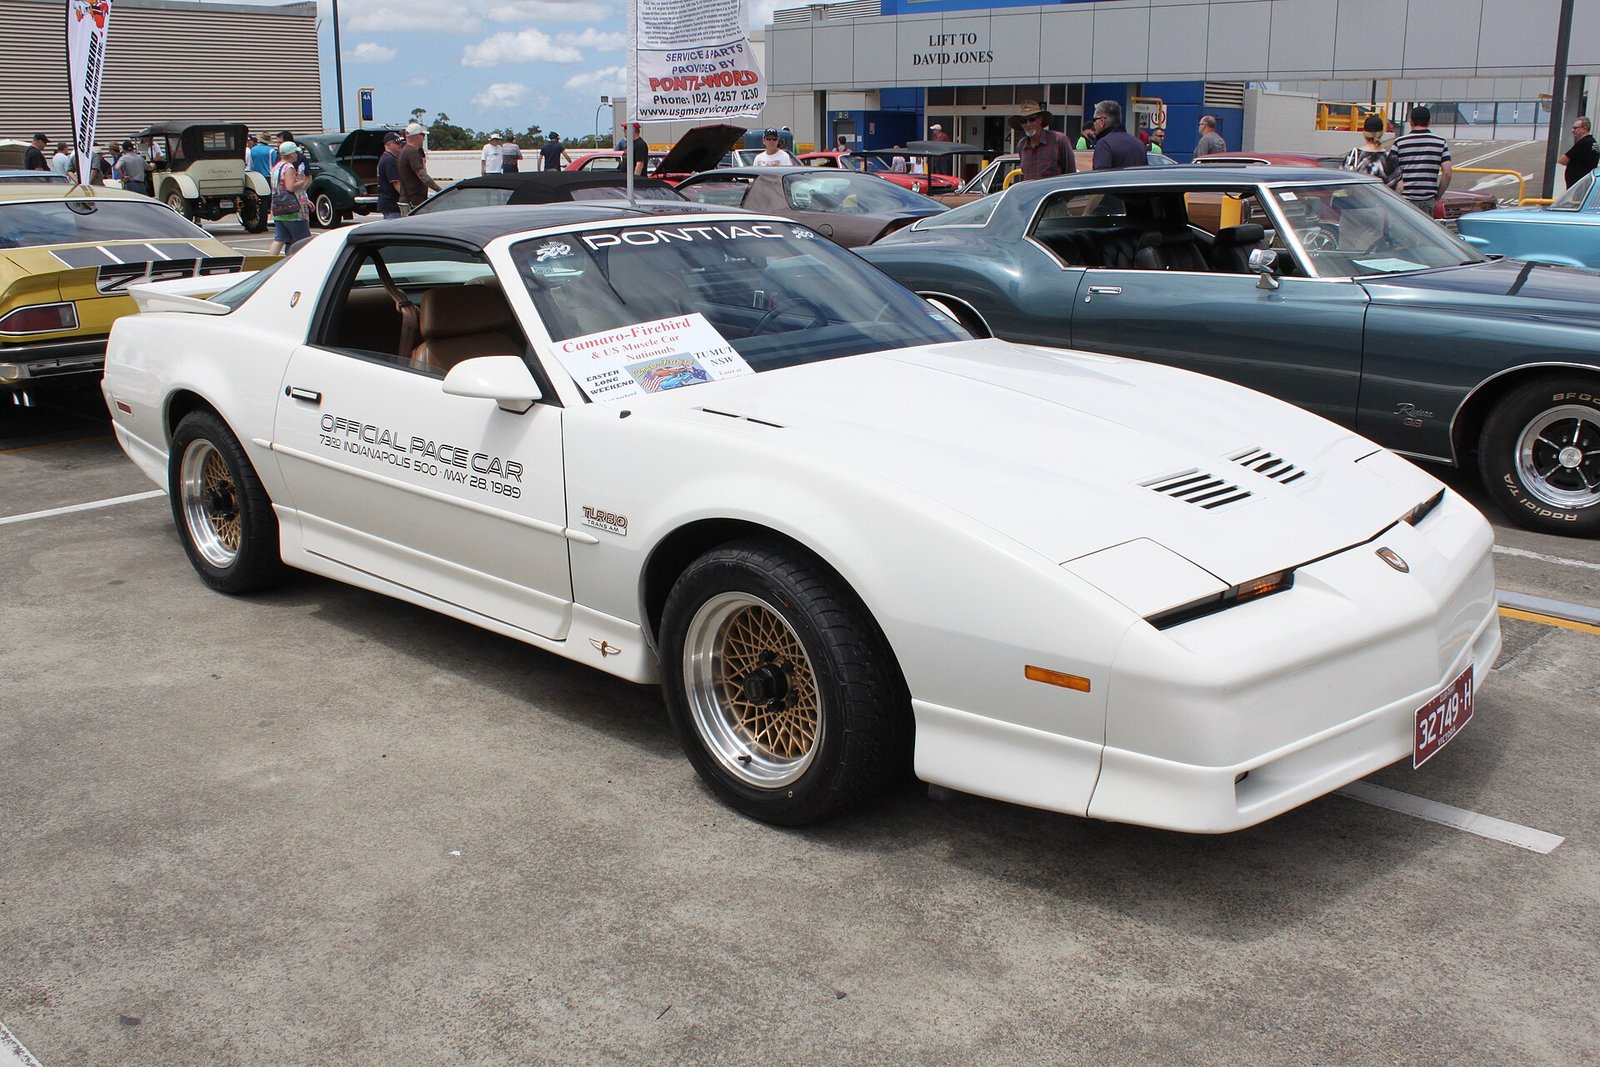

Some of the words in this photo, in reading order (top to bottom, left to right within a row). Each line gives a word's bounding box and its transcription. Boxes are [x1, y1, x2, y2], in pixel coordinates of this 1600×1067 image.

[929, 34, 957, 47] LIFT
[960, 33, 977, 45] TO
[84, 31, 99, 96] FIREBIRD
[665, 50, 704, 62] SERVICE
[913, 53, 950, 65] DAVID
[953, 51, 994, 64] JONES
[719, 59, 735, 69] BY
[653, 95, 690, 105] Phone:
[692, 94, 711, 105] (02)
[714, 91, 737, 102] 4257
[740, 88, 759, 100] 1230
[89, 105, 97, 128] Club
[78, 95, 91, 154] CAMARO
[582, 225, 785, 250] PONTIAC
[562, 317, 691, 354] Camaro-Firebird
[591, 351, 600, 360] &
[603, 346, 620, 356] US
[622, 339, 659, 352] Muscle
[661, 334, 680, 343] Car
[626, 346, 676, 361] Nationals
[695, 346, 733, 360] TUMUT
[710, 356, 734, 366] NSW
[586, 369, 620, 383] EASTER
[594, 377, 619, 388] LONG
[590, 380, 635, 396] WEEKEND
[320, 413, 407, 453] OFFICIAL
[410, 436, 469, 469] PACE
[471, 452, 524, 483] CAR
[343, 440, 411, 470] INDIANAPOLIS
[413, 460, 438, 477] 500
[443, 468, 468, 485] MAY
[490, 480, 522, 499] 1989
[587, 519, 608, 530] TRANS
